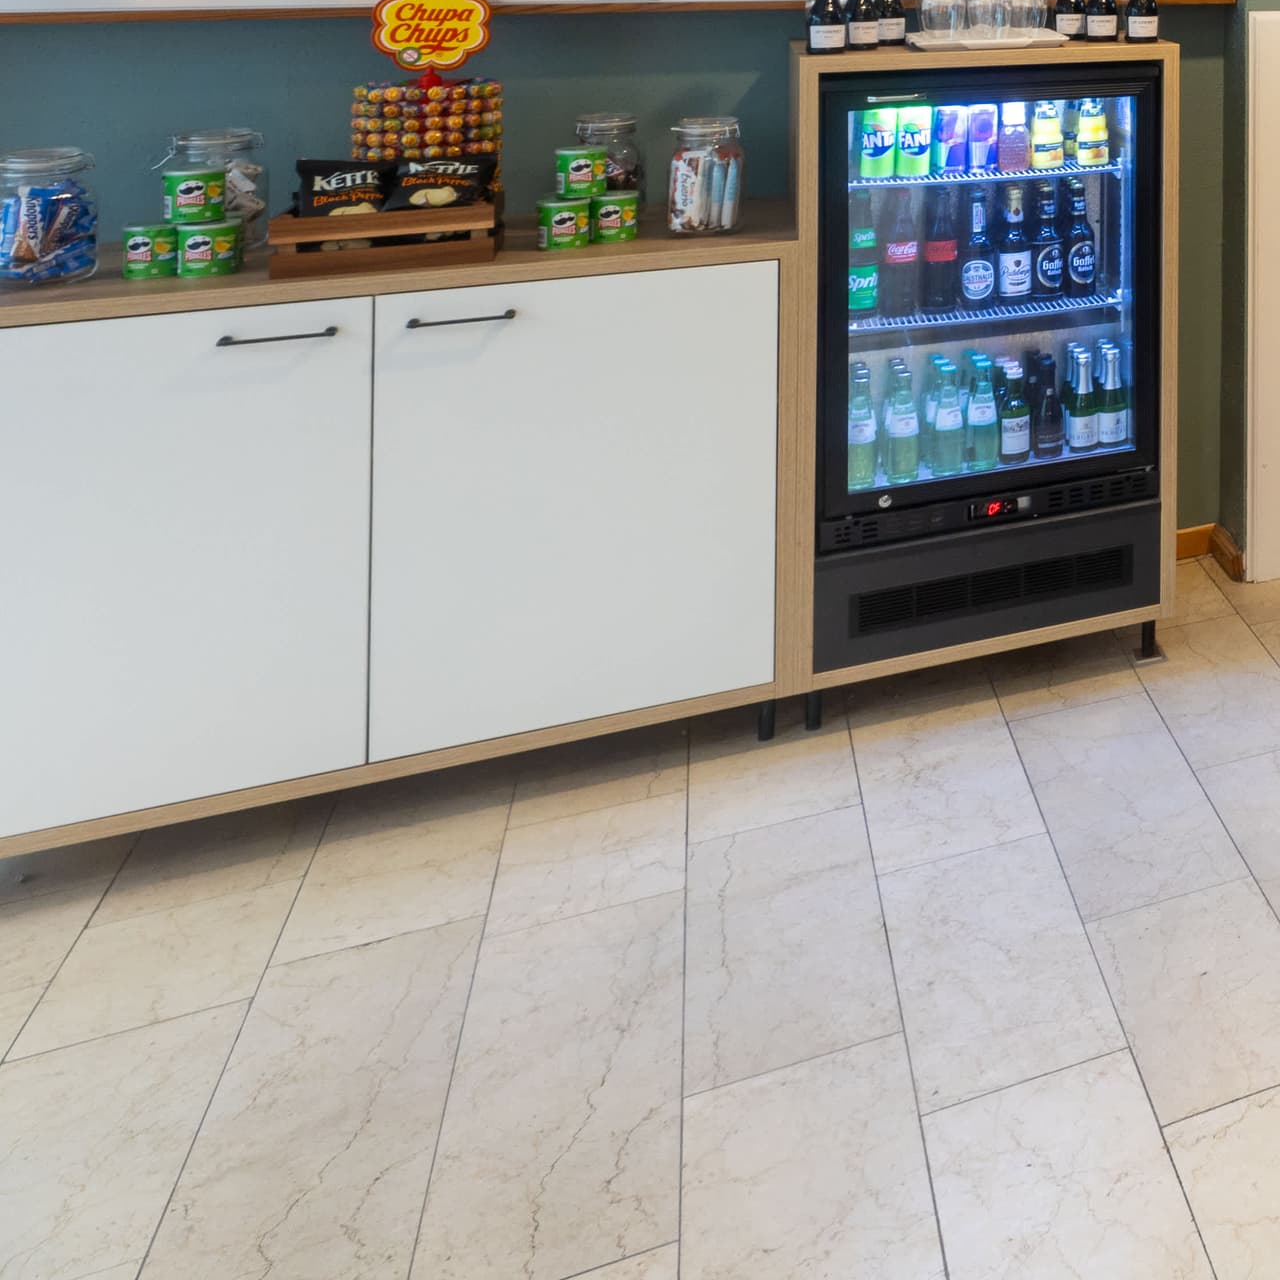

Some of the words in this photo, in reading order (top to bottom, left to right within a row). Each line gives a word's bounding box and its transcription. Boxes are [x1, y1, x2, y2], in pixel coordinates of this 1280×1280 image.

[395, 3, 475, 27] Chupa
[390, 23, 470, 55] Chups
[899, 129, 930, 148] FANT
[408, 160, 480, 175] KTTLE
